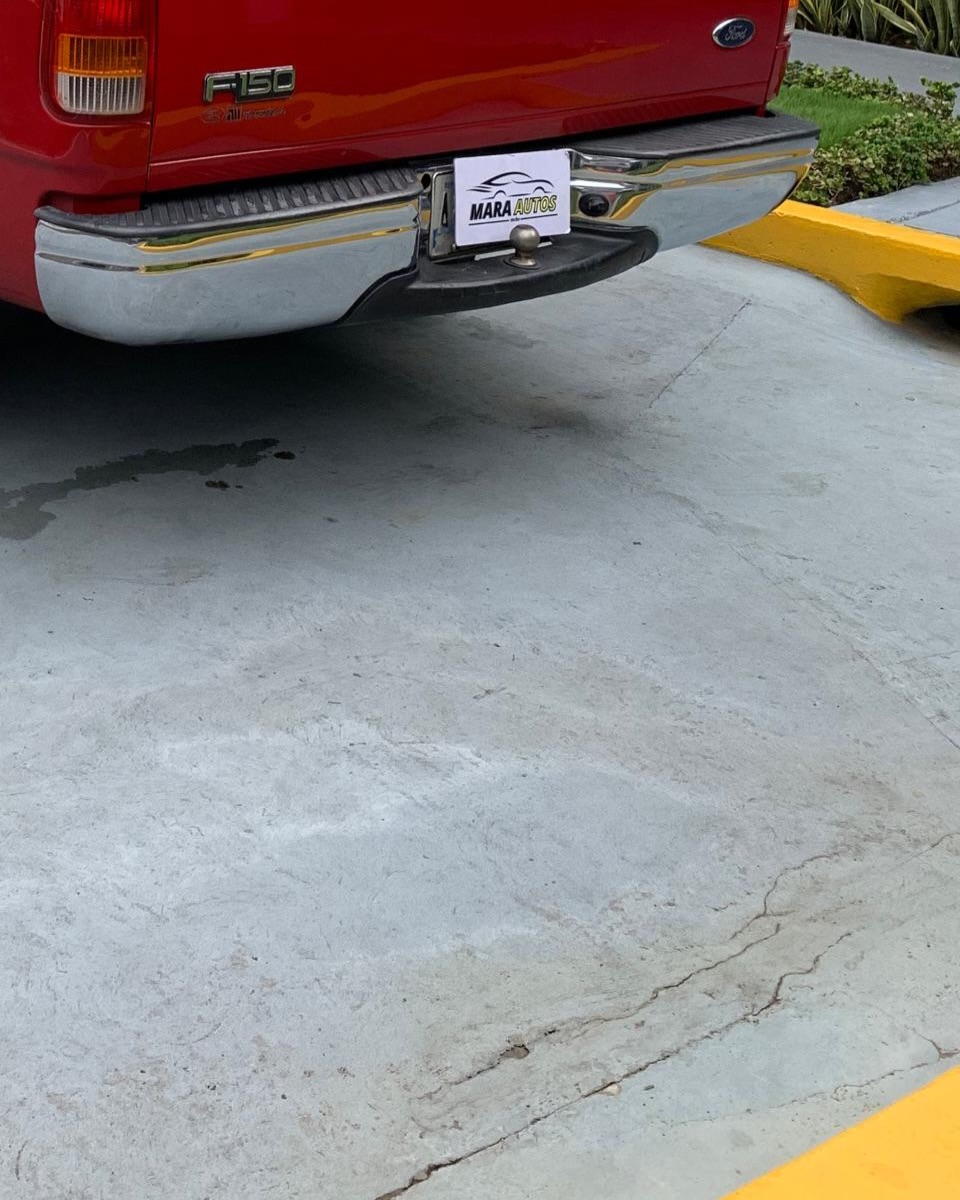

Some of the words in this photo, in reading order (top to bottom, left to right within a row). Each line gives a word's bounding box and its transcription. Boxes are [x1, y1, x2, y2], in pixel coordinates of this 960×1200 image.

[724, 25, 748, 41] Ford
[470, 200, 511, 221] MARA
[513, 195, 558, 215] AUTOS
